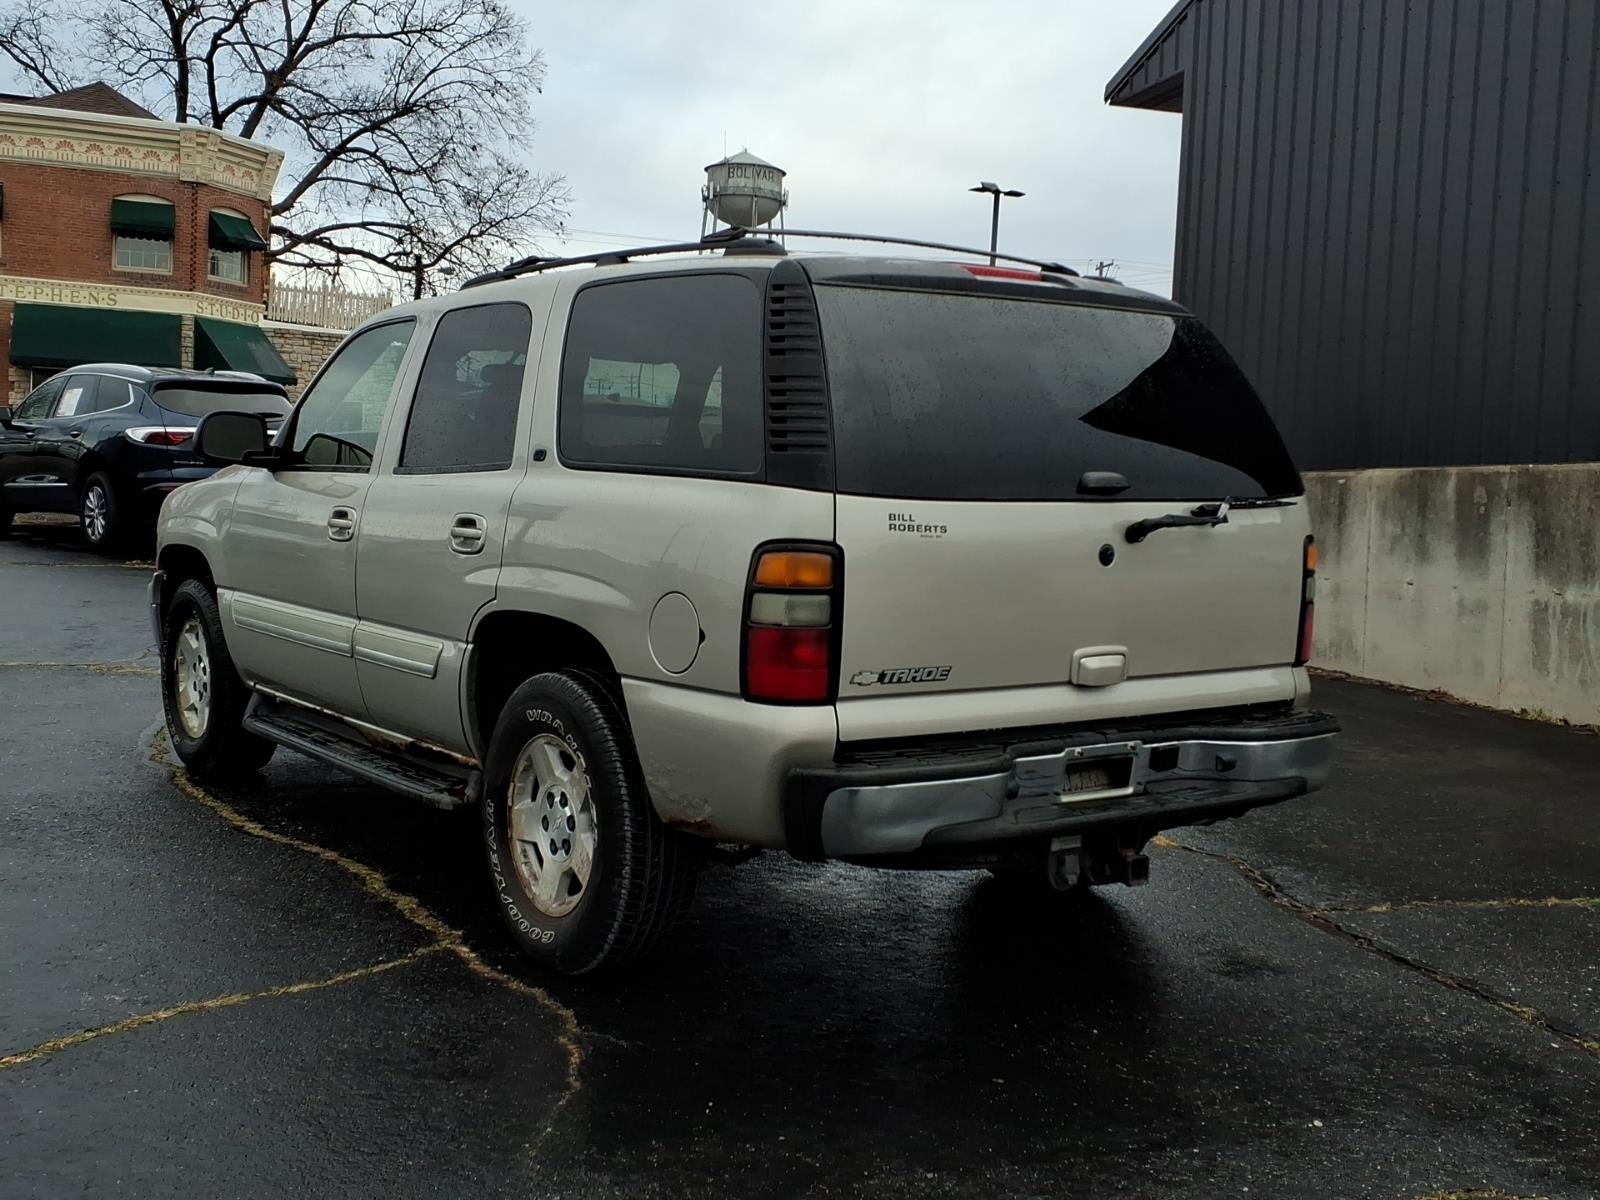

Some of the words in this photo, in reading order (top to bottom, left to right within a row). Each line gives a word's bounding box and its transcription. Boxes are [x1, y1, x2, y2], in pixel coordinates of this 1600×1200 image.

[728, 166, 774, 182] BOLIVAR
[888, 513, 916, 522] BILL
[888, 523, 948, 534] ROBERTS
[880, 666, 952, 685] TAHOE
